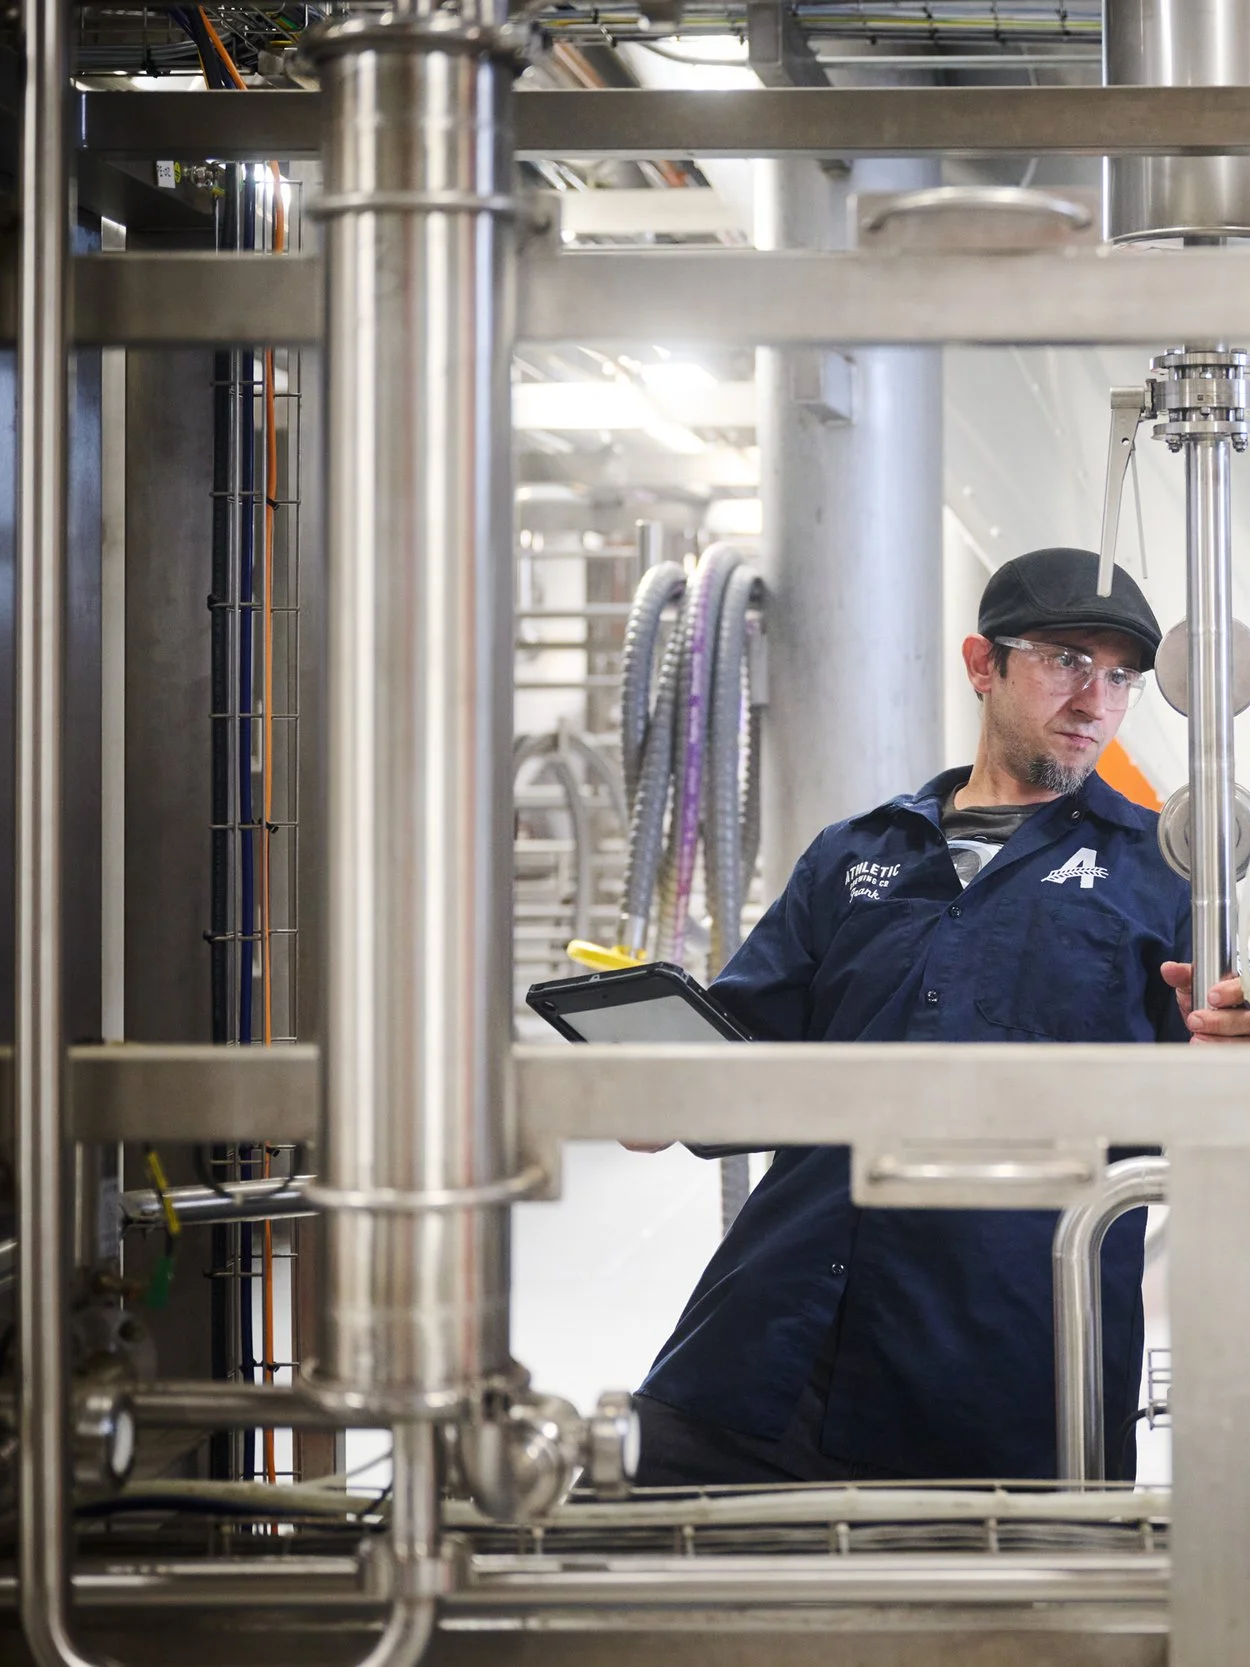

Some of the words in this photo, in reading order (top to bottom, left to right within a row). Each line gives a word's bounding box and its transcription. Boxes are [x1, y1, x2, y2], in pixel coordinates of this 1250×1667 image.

[845, 861, 901, 885] ATHLETIC
[1046, 847, 1098, 888] A
[849, 887, 880, 903] Frank
